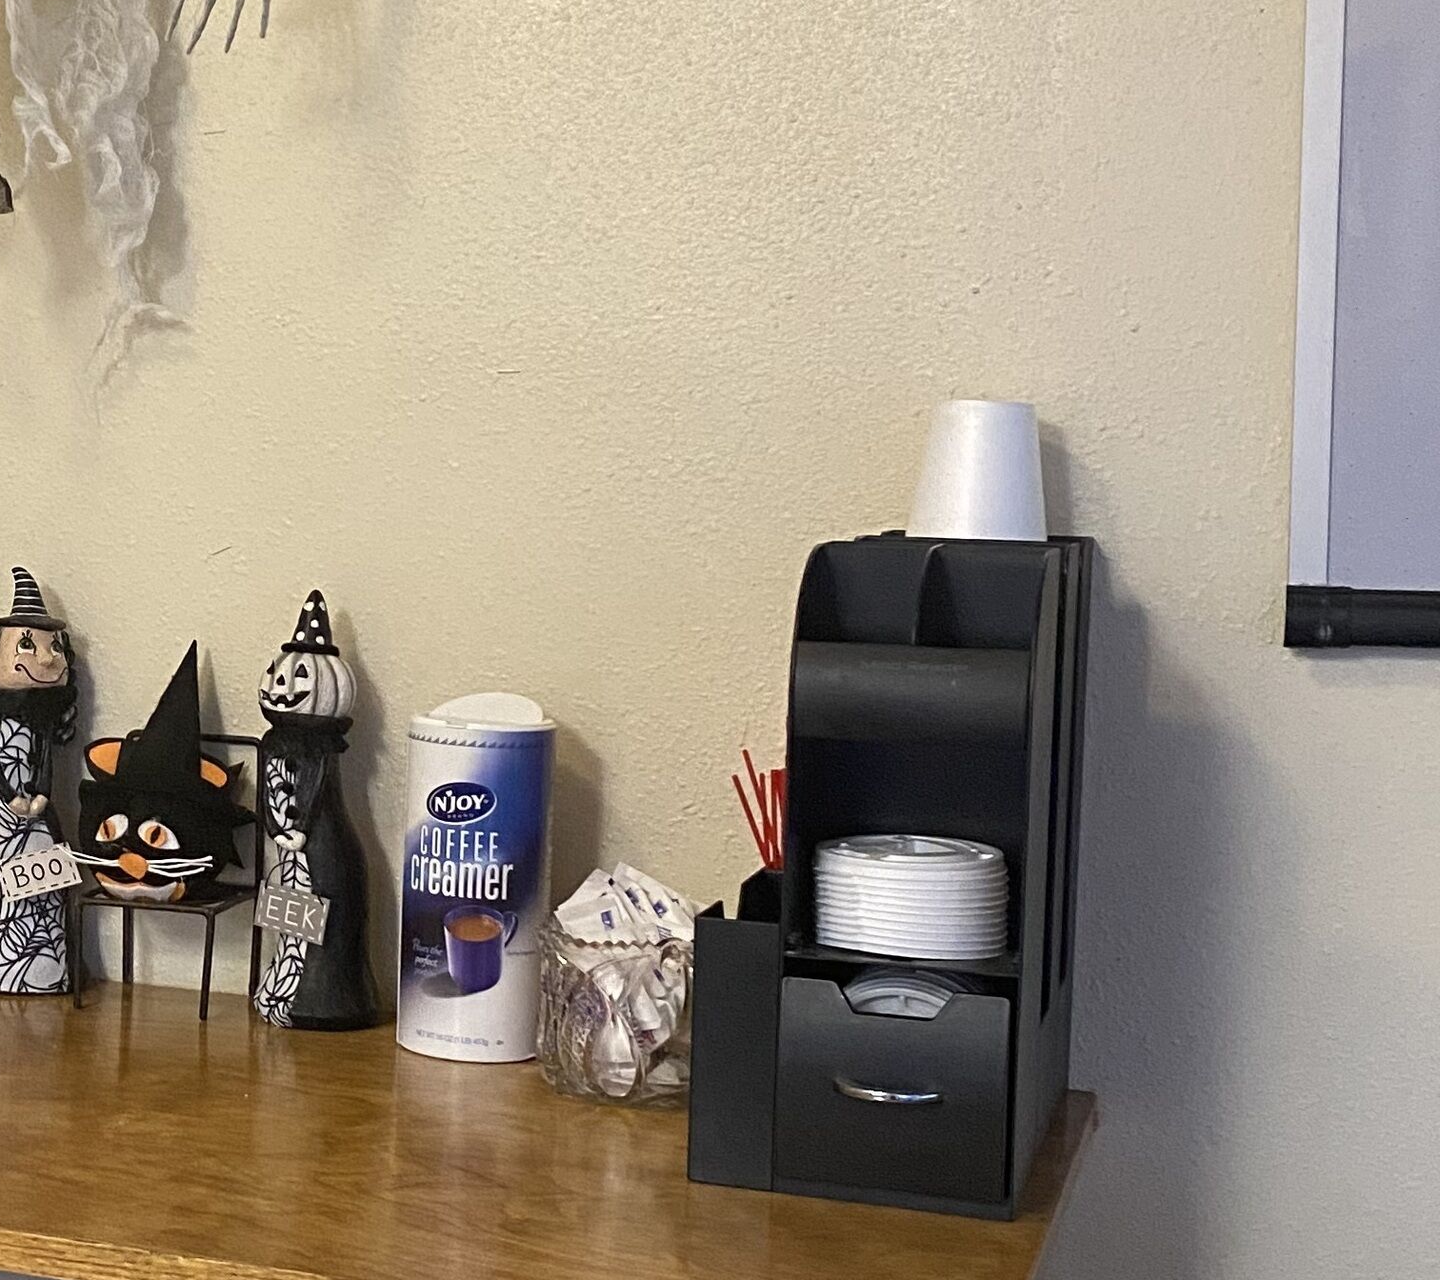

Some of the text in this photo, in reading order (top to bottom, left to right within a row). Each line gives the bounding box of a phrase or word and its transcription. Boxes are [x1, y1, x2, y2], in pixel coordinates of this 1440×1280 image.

[420, 825, 499, 862] COFFEE
[10, 858, 62, 888] BOO
[411, 854, 514, 900] creamer
[266, 895, 317, 930] EEK
